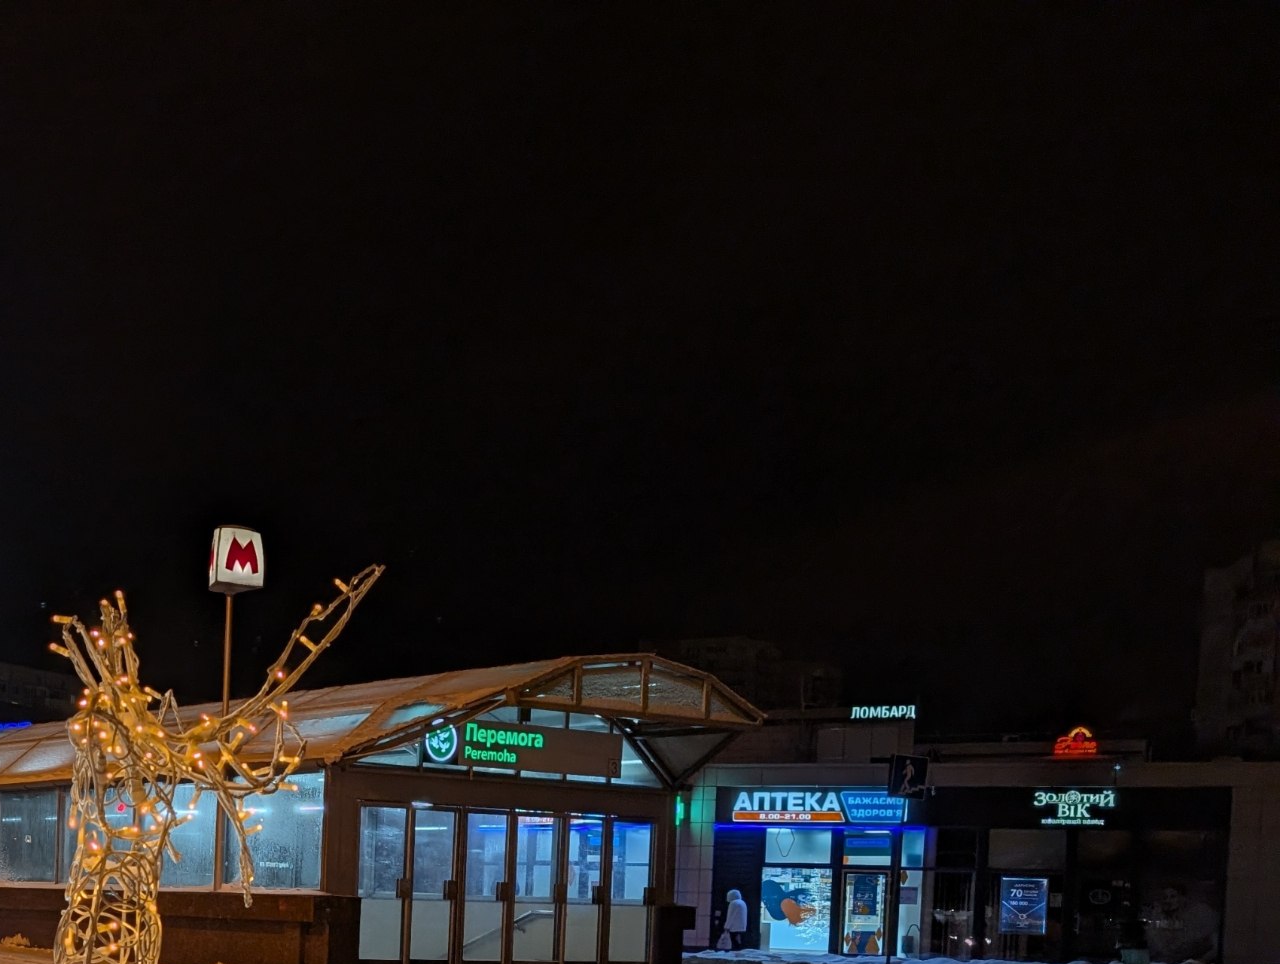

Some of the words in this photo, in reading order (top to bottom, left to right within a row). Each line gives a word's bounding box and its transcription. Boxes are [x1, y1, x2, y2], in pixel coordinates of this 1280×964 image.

[225, 535, 259, 574] М
[850, 705, 916, 719] ЛОМБАРД
[465, 722, 544, 748] Перемога
[464, 745, 517, 763] Peremoha
[733, 791, 842, 812] АПТЕКА
[847, 796, 904, 806] БАЖАЄМО
[850, 808, 903, 818] ЗДОРОВ'Я
[1010, 888, 1023, 898] 70
